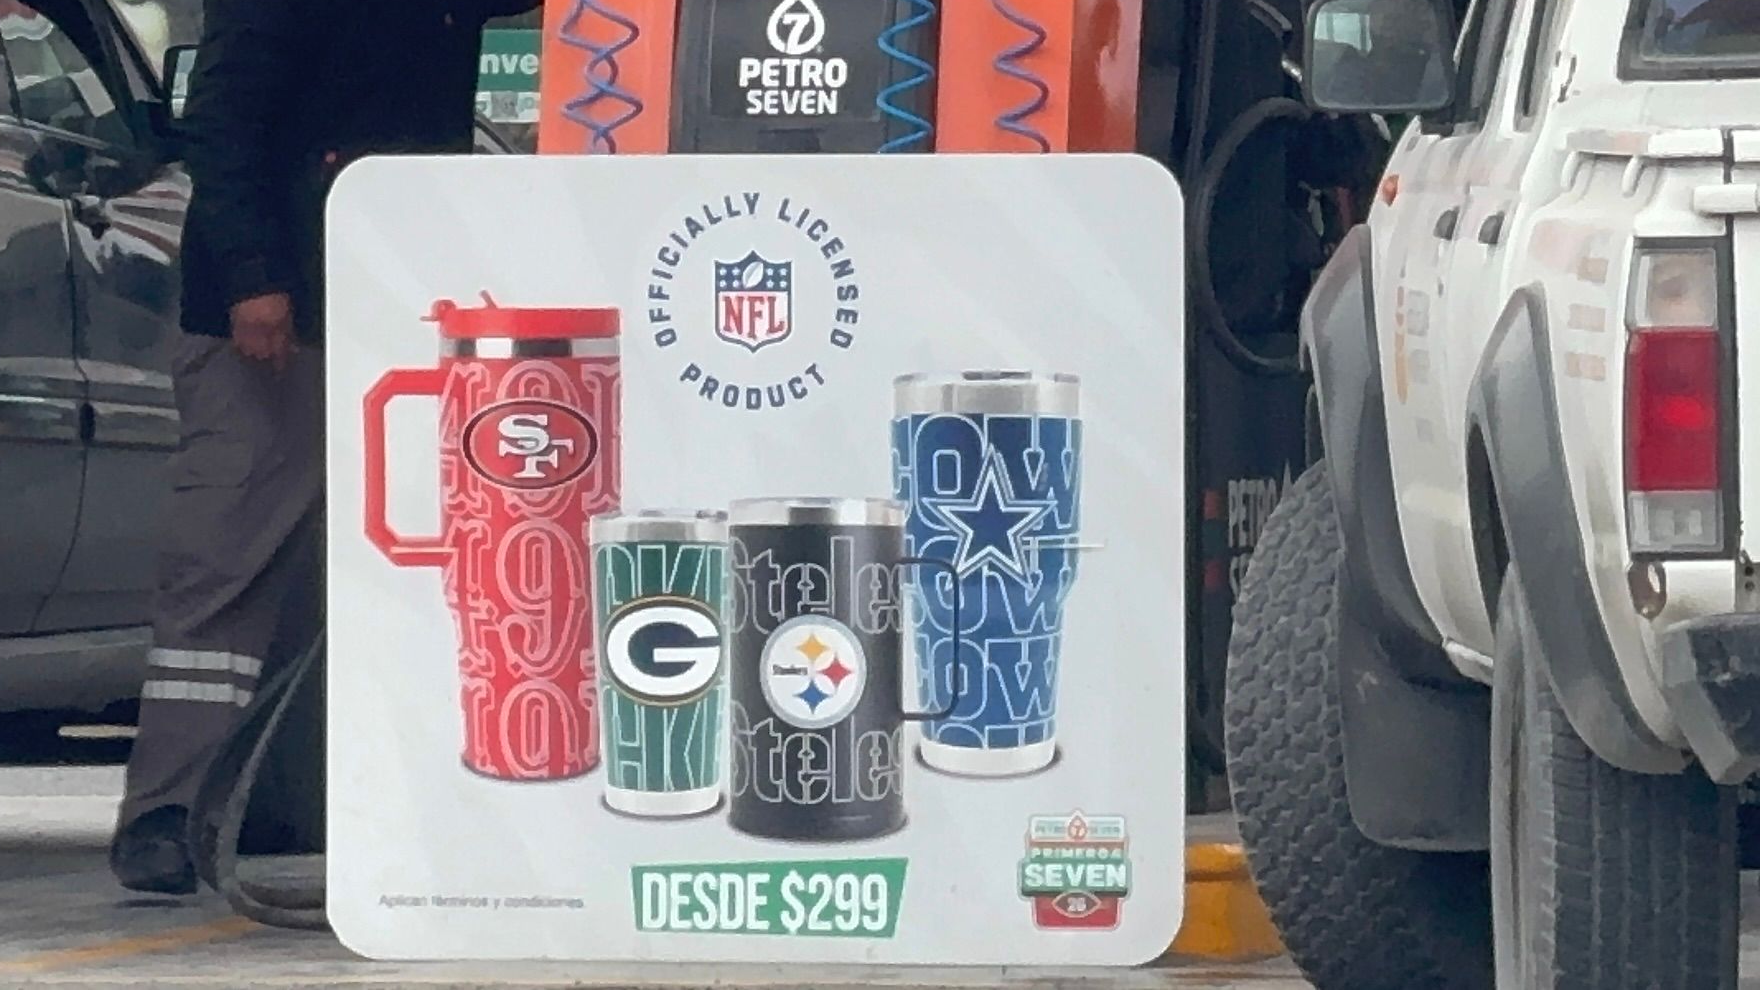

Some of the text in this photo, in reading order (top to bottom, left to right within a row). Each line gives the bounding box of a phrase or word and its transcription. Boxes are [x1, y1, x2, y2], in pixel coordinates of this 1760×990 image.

[739, 58, 847, 89] PETRO
[745, 90, 839, 115] SEVEN
[647, 192, 860, 350] OFFICIALLY LICENSED
[722, 295, 786, 341] NFL
[679, 363, 826, 411] PRODUCT
[606, 605, 721, 696] G
[1024, 862, 1127, 887] SEVEN
[642, 868, 889, 933] DESDE $299
